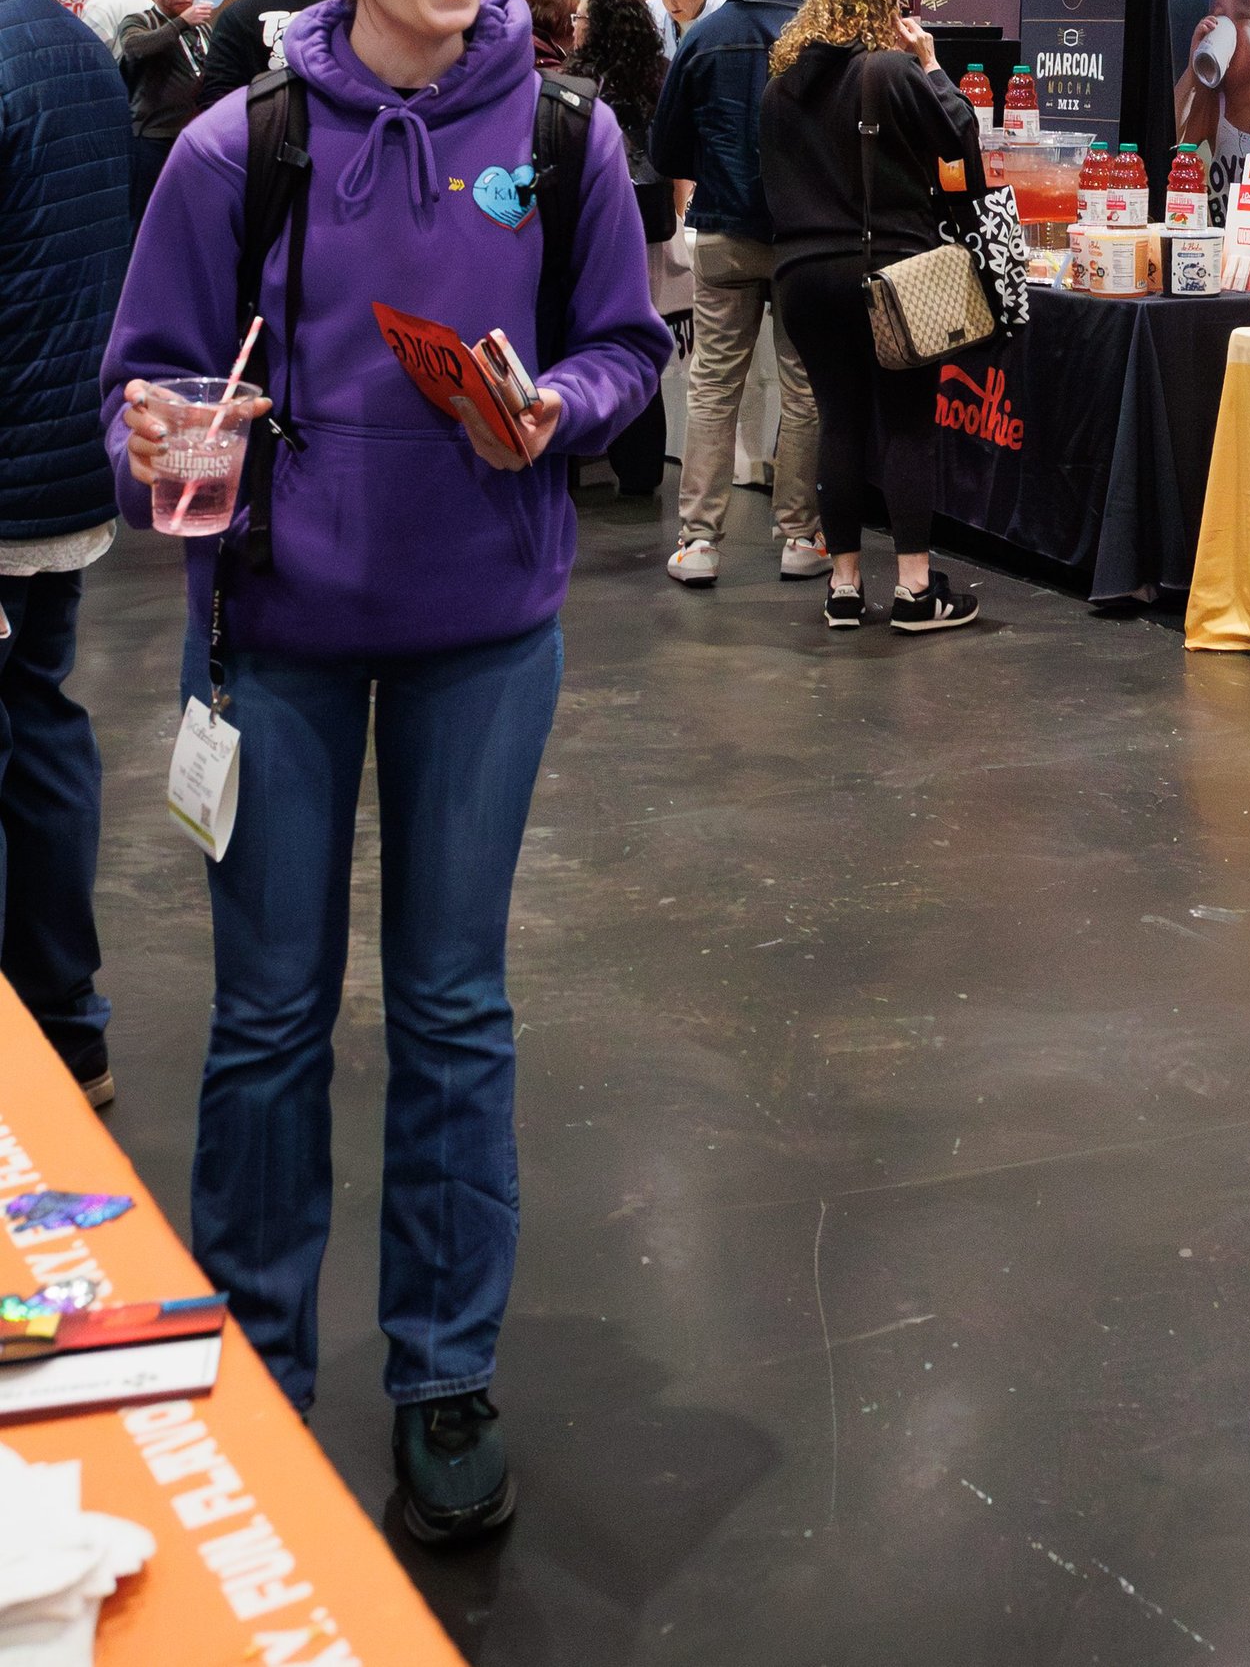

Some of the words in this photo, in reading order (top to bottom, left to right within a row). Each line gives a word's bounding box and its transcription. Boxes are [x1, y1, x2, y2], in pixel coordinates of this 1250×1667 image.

[1036, 52, 1105, 81] CHARCOAL
[1047, 81, 1092, 95] MOCHA
[1057, 98, 1080, 111] MIX
[122, 1399, 256, 1531] FLAVO
